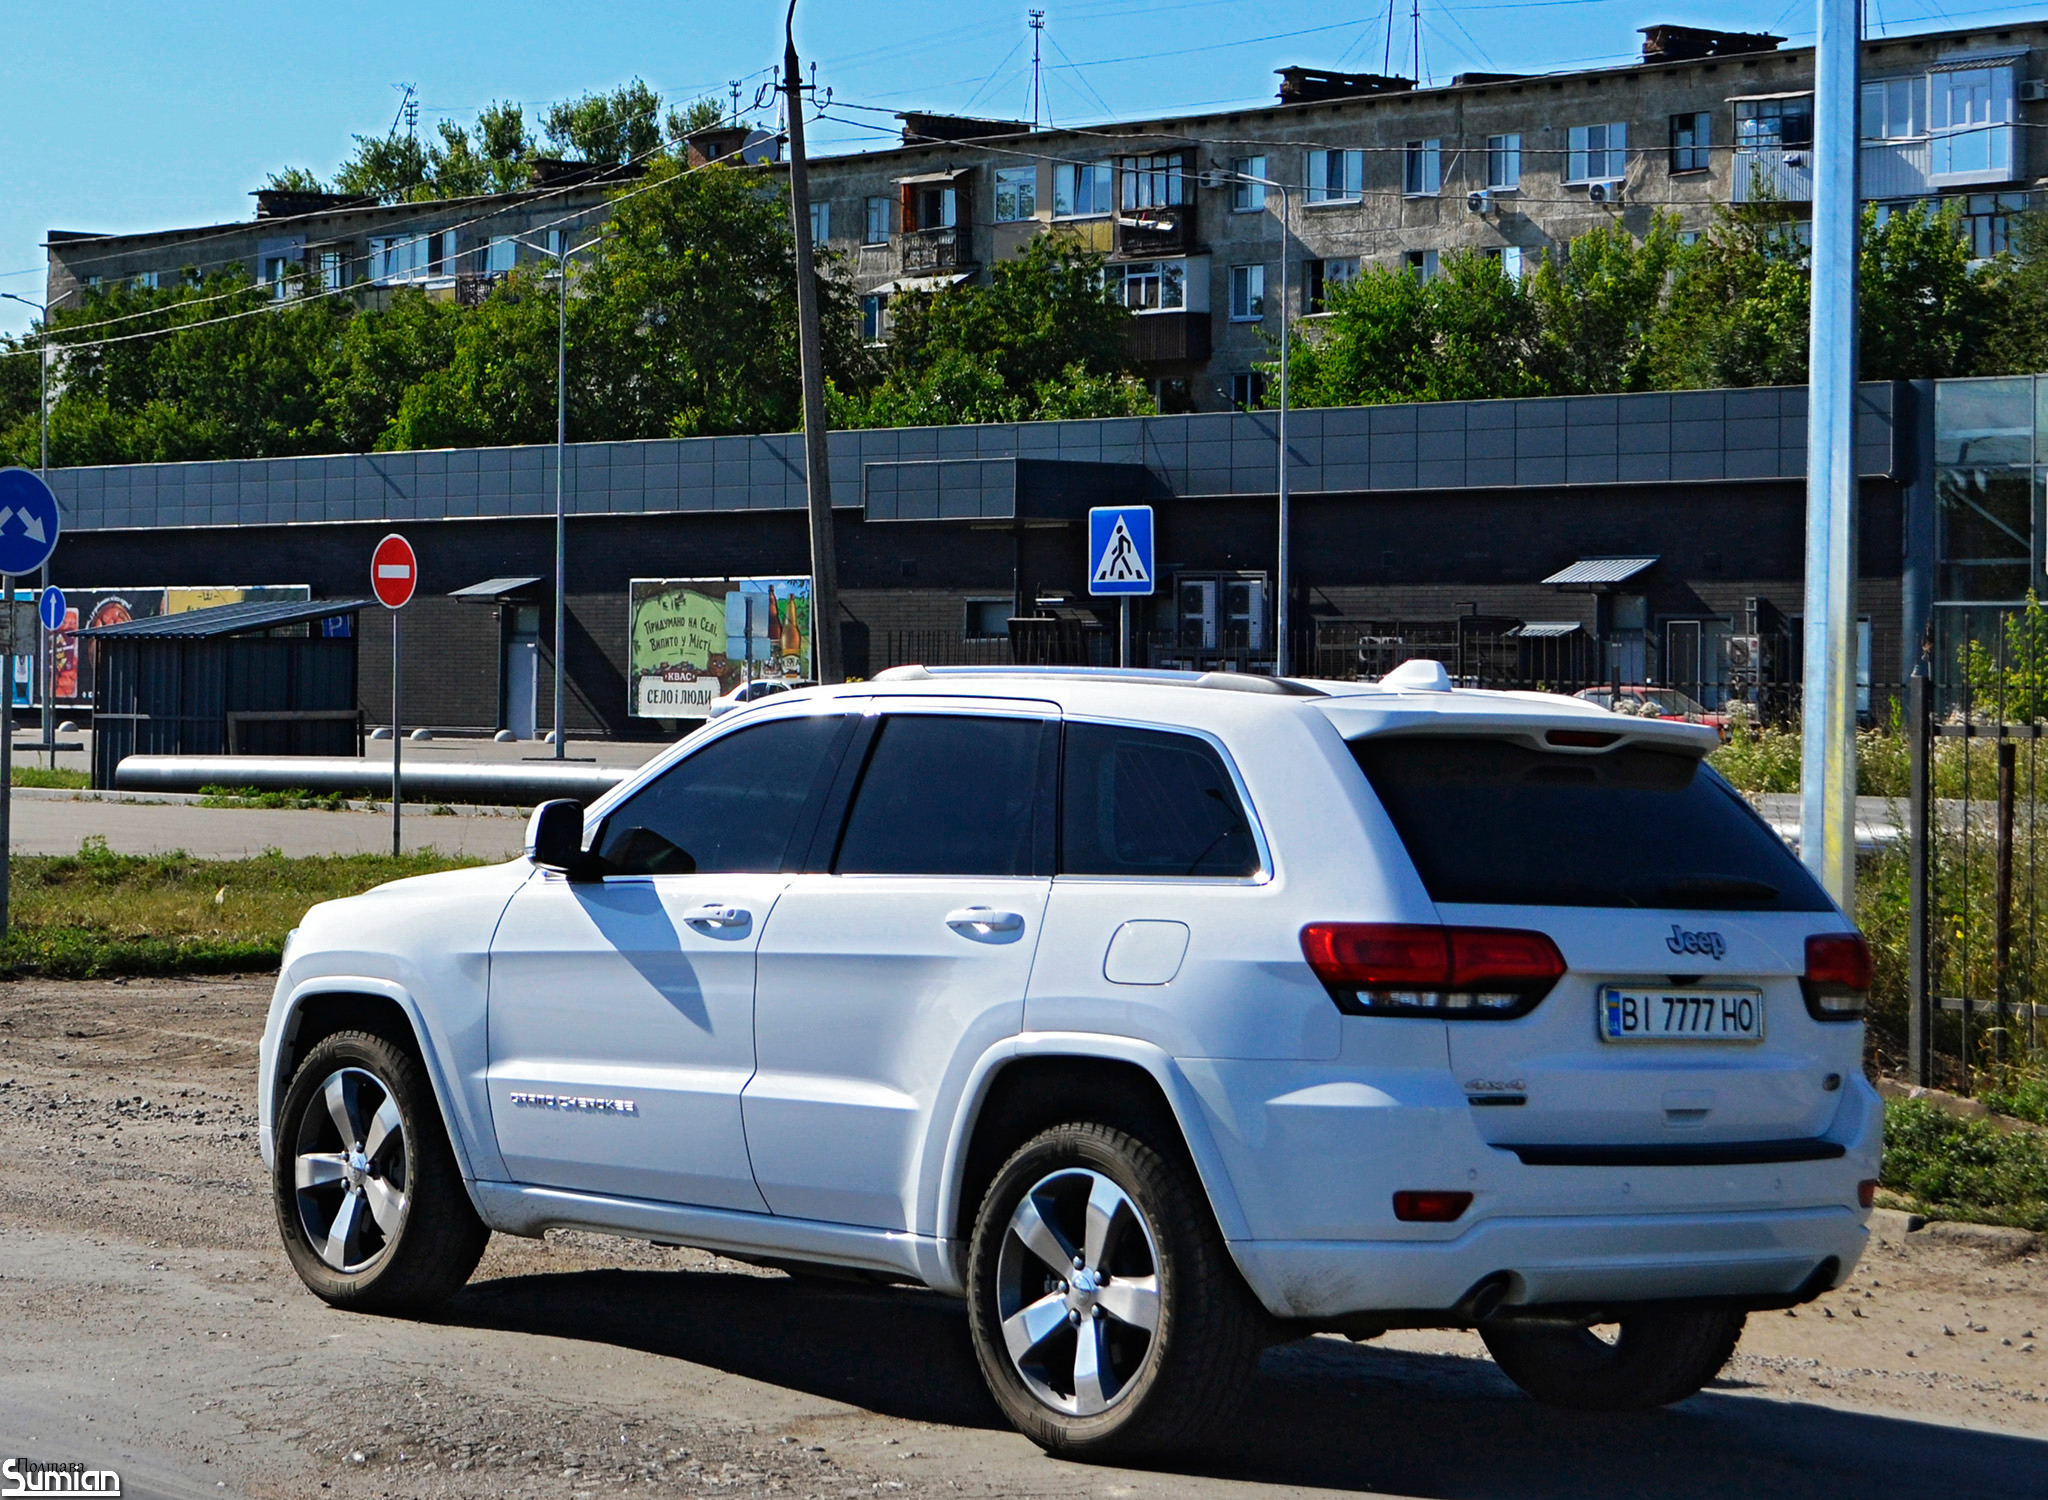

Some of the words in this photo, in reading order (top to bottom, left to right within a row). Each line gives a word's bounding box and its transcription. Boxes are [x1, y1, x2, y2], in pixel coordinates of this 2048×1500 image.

[667, 672, 692, 681] КВАС
[647, 689, 673, 704] СЕЛО
[680, 689, 712, 710] ЛЮДИ
[1665, 924, 1726, 960] Jeep
[1622, 997, 1649, 1031] BI
[1662, 997, 1714, 1031] 7777
[1721, 997, 1753, 1031] HO
